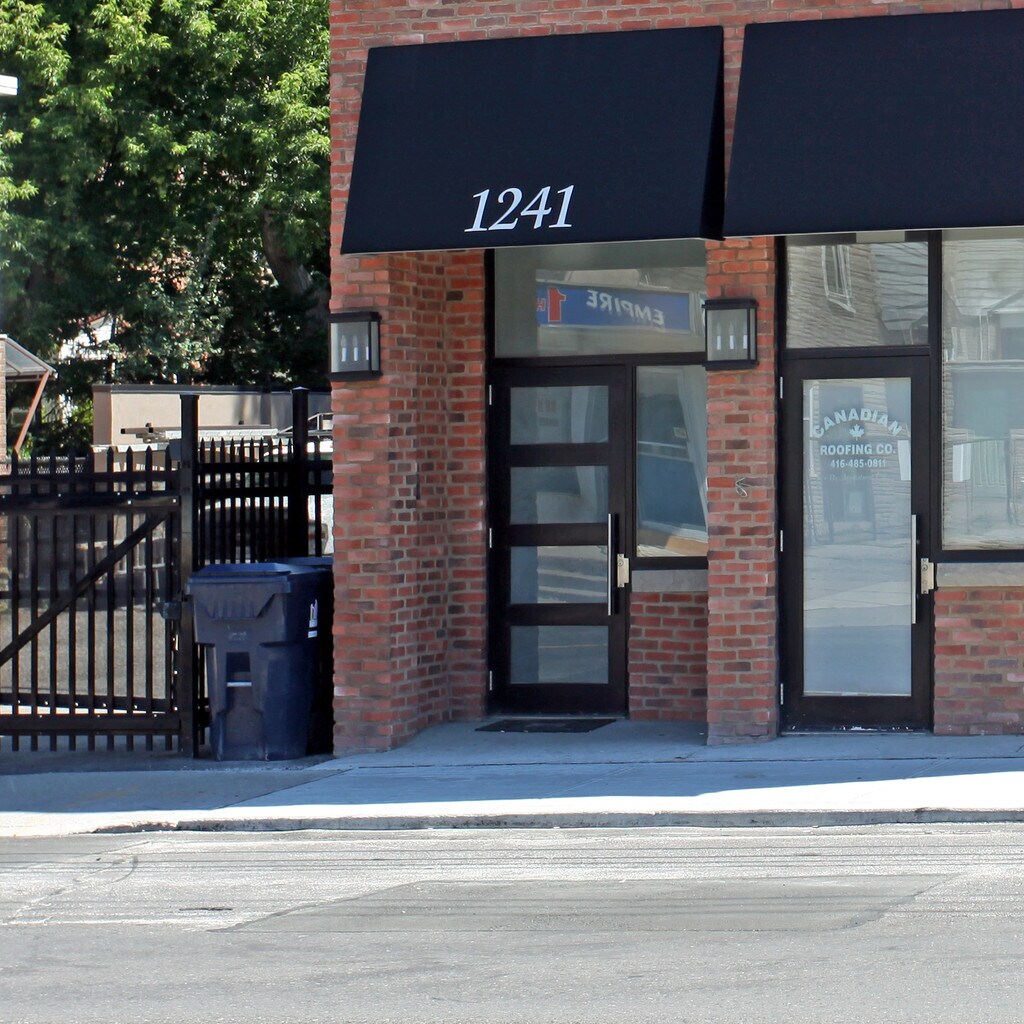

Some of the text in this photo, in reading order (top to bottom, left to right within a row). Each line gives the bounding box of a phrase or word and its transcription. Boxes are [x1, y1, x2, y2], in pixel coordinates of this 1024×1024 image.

[464, 184, 574, 233] 1241
[813, 408, 903, 439] CANADIAN
[820, 443, 896, 455] ROOFING CO.
